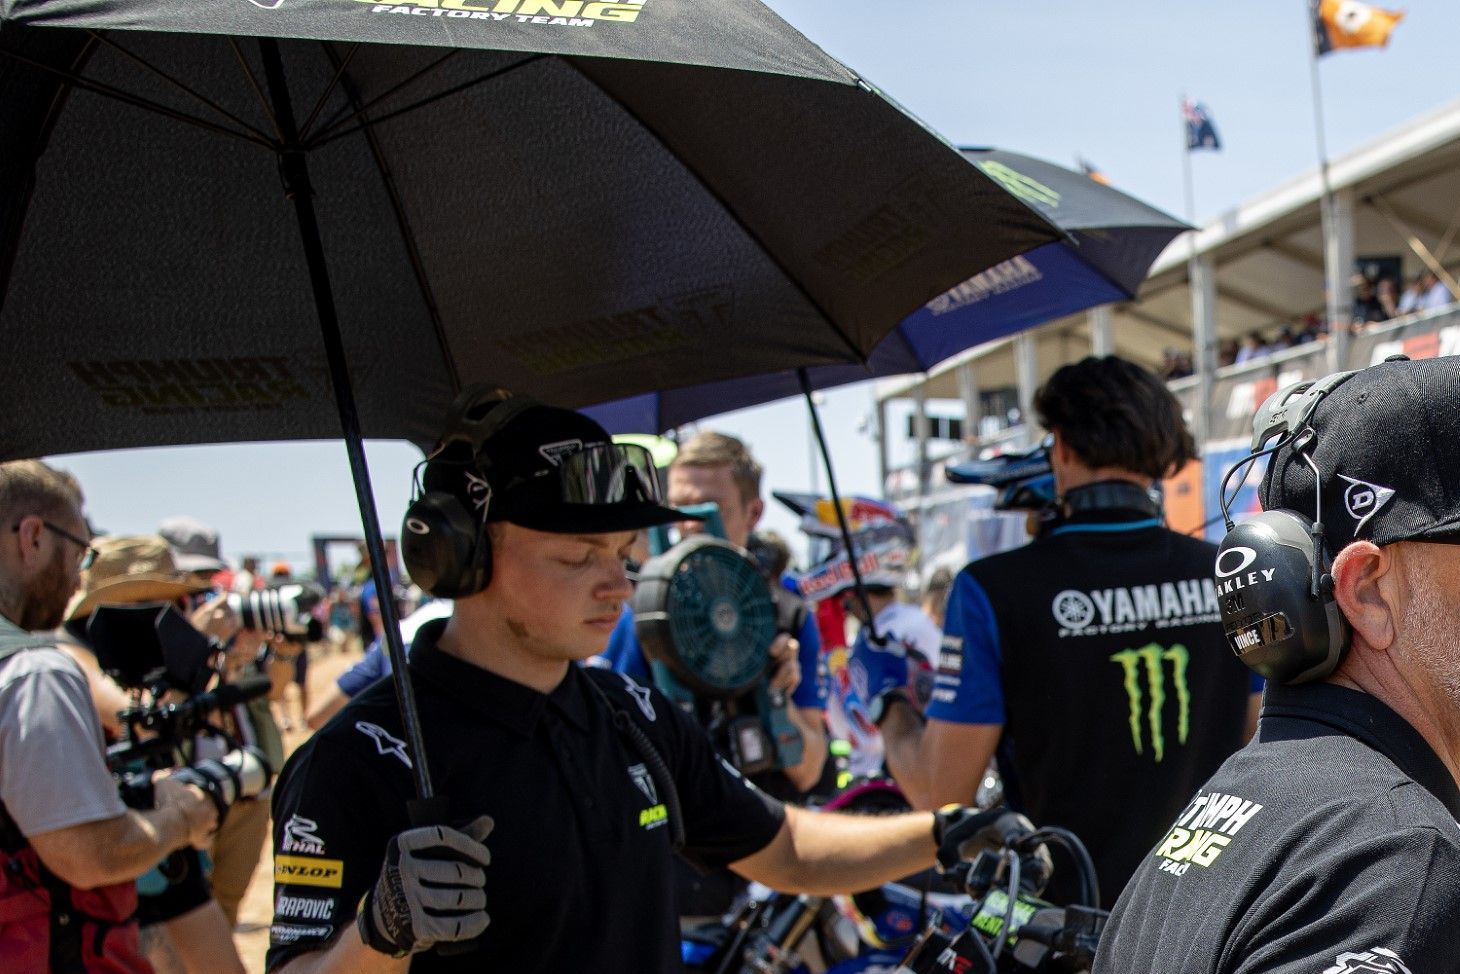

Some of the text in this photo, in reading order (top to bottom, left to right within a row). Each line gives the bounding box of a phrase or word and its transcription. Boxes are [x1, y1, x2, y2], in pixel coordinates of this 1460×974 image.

[372, 5, 595, 27] FACTORY TEAM
[1217, 568, 1275, 597] AKLEY
[1091, 578, 1221, 625] YAMAHA
[1234, 629, 1261, 651] VINCE
